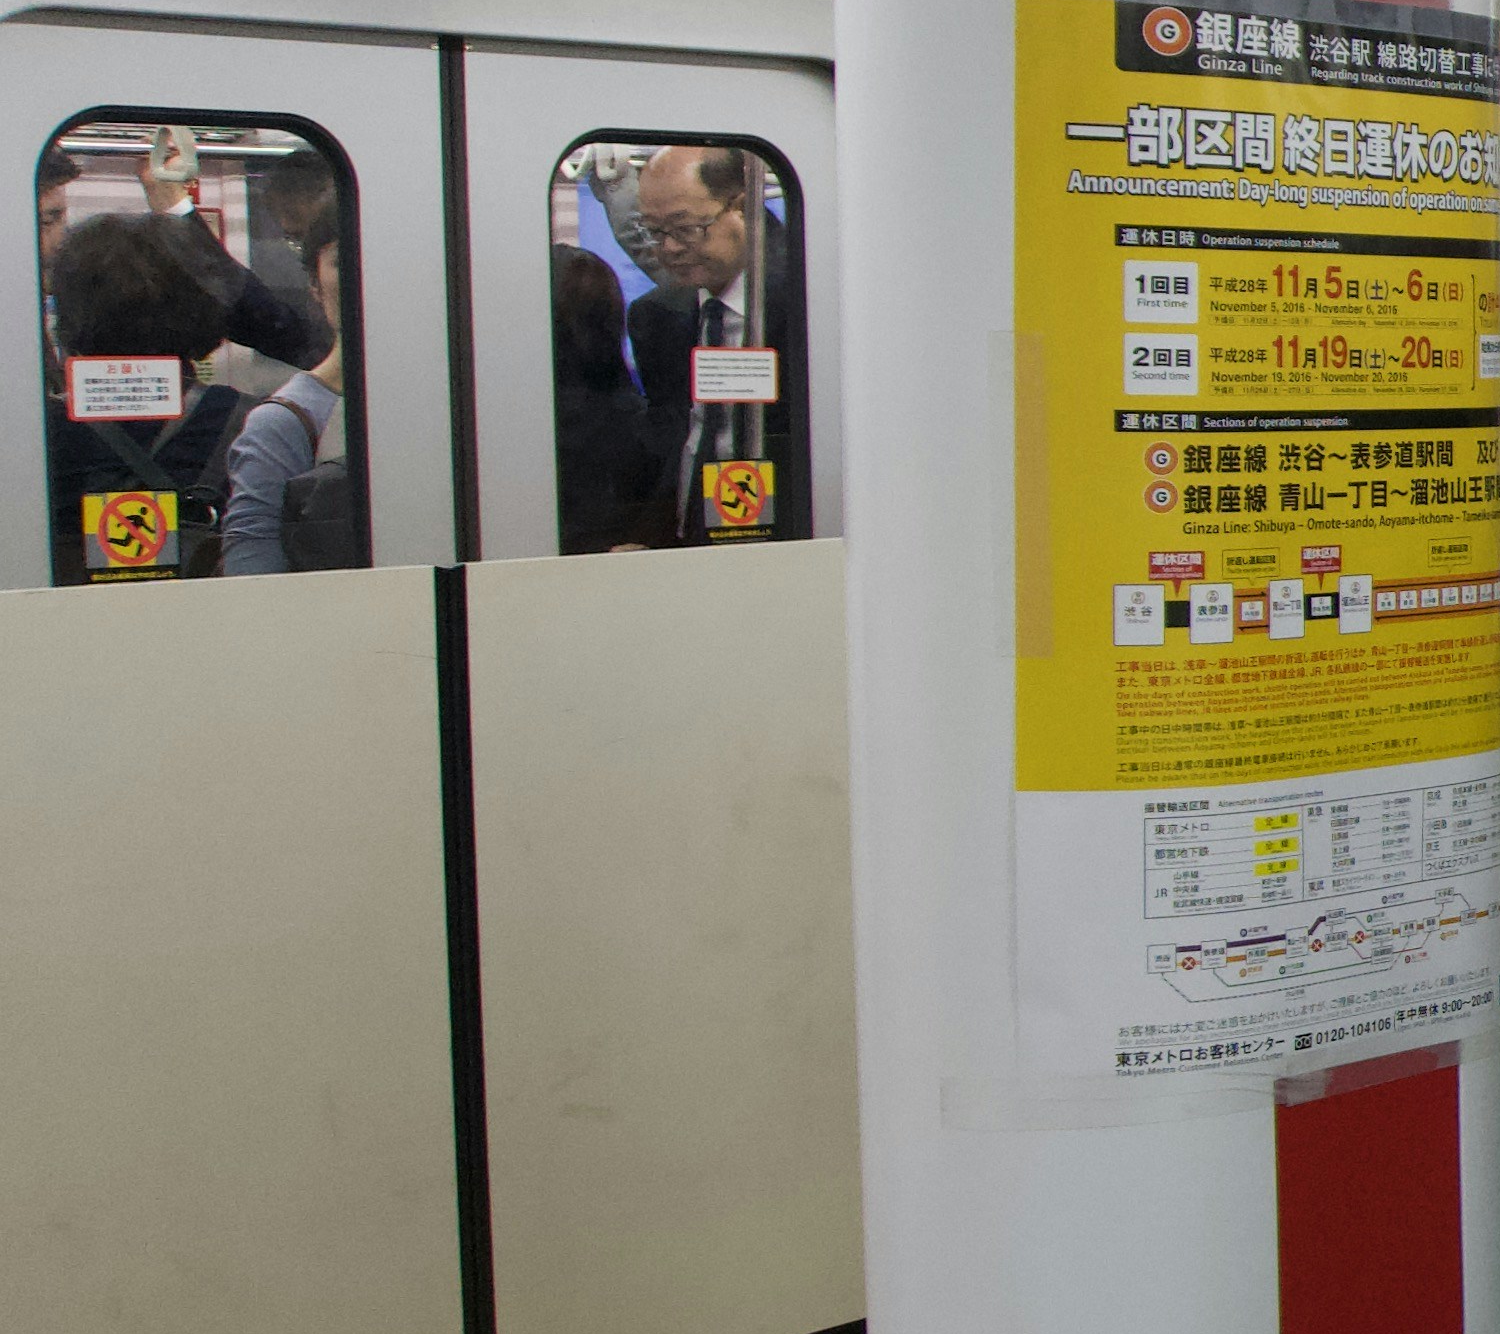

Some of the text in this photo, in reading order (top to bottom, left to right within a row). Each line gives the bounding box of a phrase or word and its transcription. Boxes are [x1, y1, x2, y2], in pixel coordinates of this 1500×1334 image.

[1160, 24, 1176, 38] G
[1195, 10, 1301, 59] 銀座線
[1309, 34, 1371, 67] 渋谷駅
[1198, 54, 1283, 76] Ginza Line
[1311, 67, 1358, 84] Regarding
[1361, 72, 1384, 84] track
[1387, 75, 1442, 89] construction
[1065, 103, 1276, 172] 一部区間
[1067, 169, 1234, 199] Announcement:
[1239, 178, 1307, 208] Day-long
[1312, 185, 1389, 209] suspension
[1392, 187, 1408, 208] of
[1409, 189, 1468, 214] operation
[1121, 228, 1195, 246] 運休日時
[1202, 233, 1252, 247] Operation
[1135, 274, 1189, 295] 1回目
[1137, 297, 1188, 308] First time
[1210, 301, 1266, 312] November
[1283, 302, 1305, 313] 2016
[1315, 303, 1362, 314] November
[1132, 347, 1191, 367] 2回目
[1132, 371, 1166, 380] Second
[1211, 372, 1267, 383] November
[1289, 372, 1312, 383] 2016
[1321, 373, 1369, 383] November
[1122, 414, 1197, 429] 運休区間
[1204, 417, 1245, 428] Sections
[1248, 416, 1258, 427] of
[1184, 445, 1267, 473] 銀座線
[1184, 485, 1267, 514] 銀座線
[1183, 522, 1219, 535] Ginza
[1224, 521, 1251, 533] Line:
[1254, 519, 1296, 533] Shibuya
[1307, 516, 1376, 530] Omote-sando,
[1316, 1017, 1391, 1045] 0120-104106
